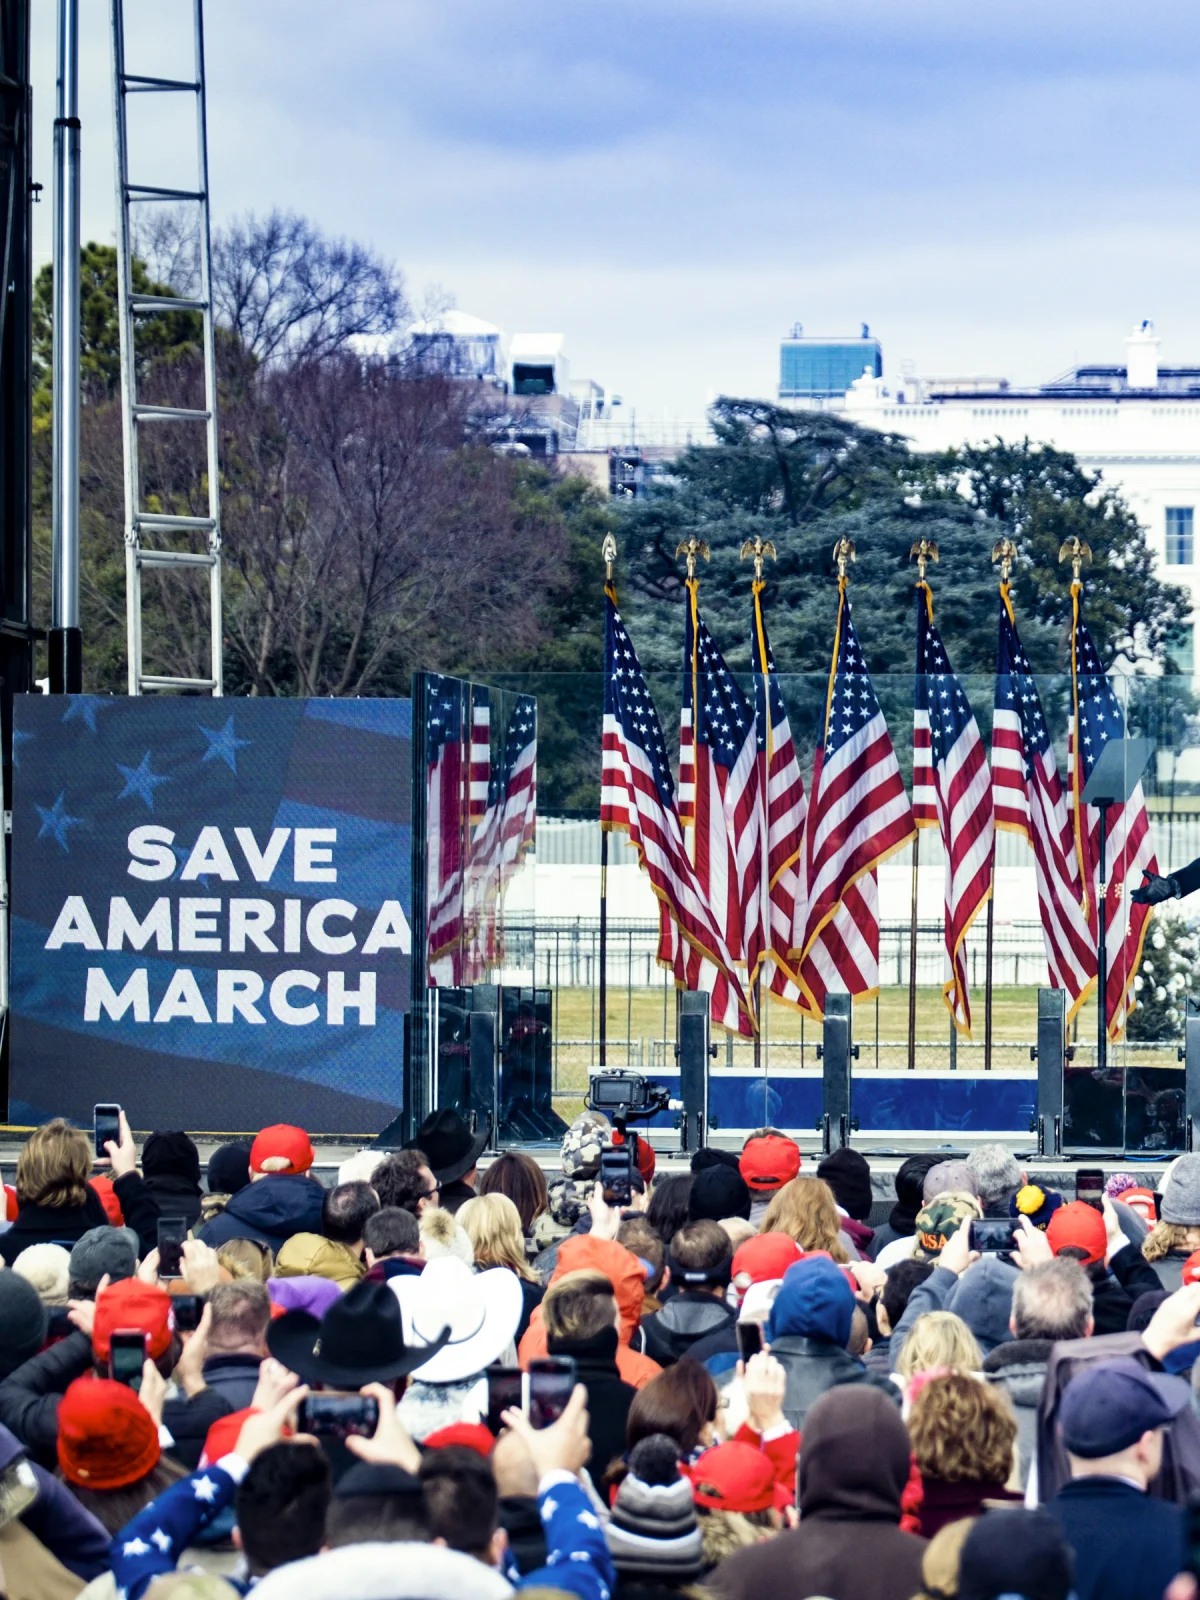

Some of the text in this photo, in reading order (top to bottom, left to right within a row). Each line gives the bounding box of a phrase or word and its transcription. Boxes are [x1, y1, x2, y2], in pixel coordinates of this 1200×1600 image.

[127, 824, 338, 883] SAVE
[44, 895, 412, 955] AMERICA
[83, 967, 377, 1026] MARCH
[921, 1232, 948, 1250] USA
